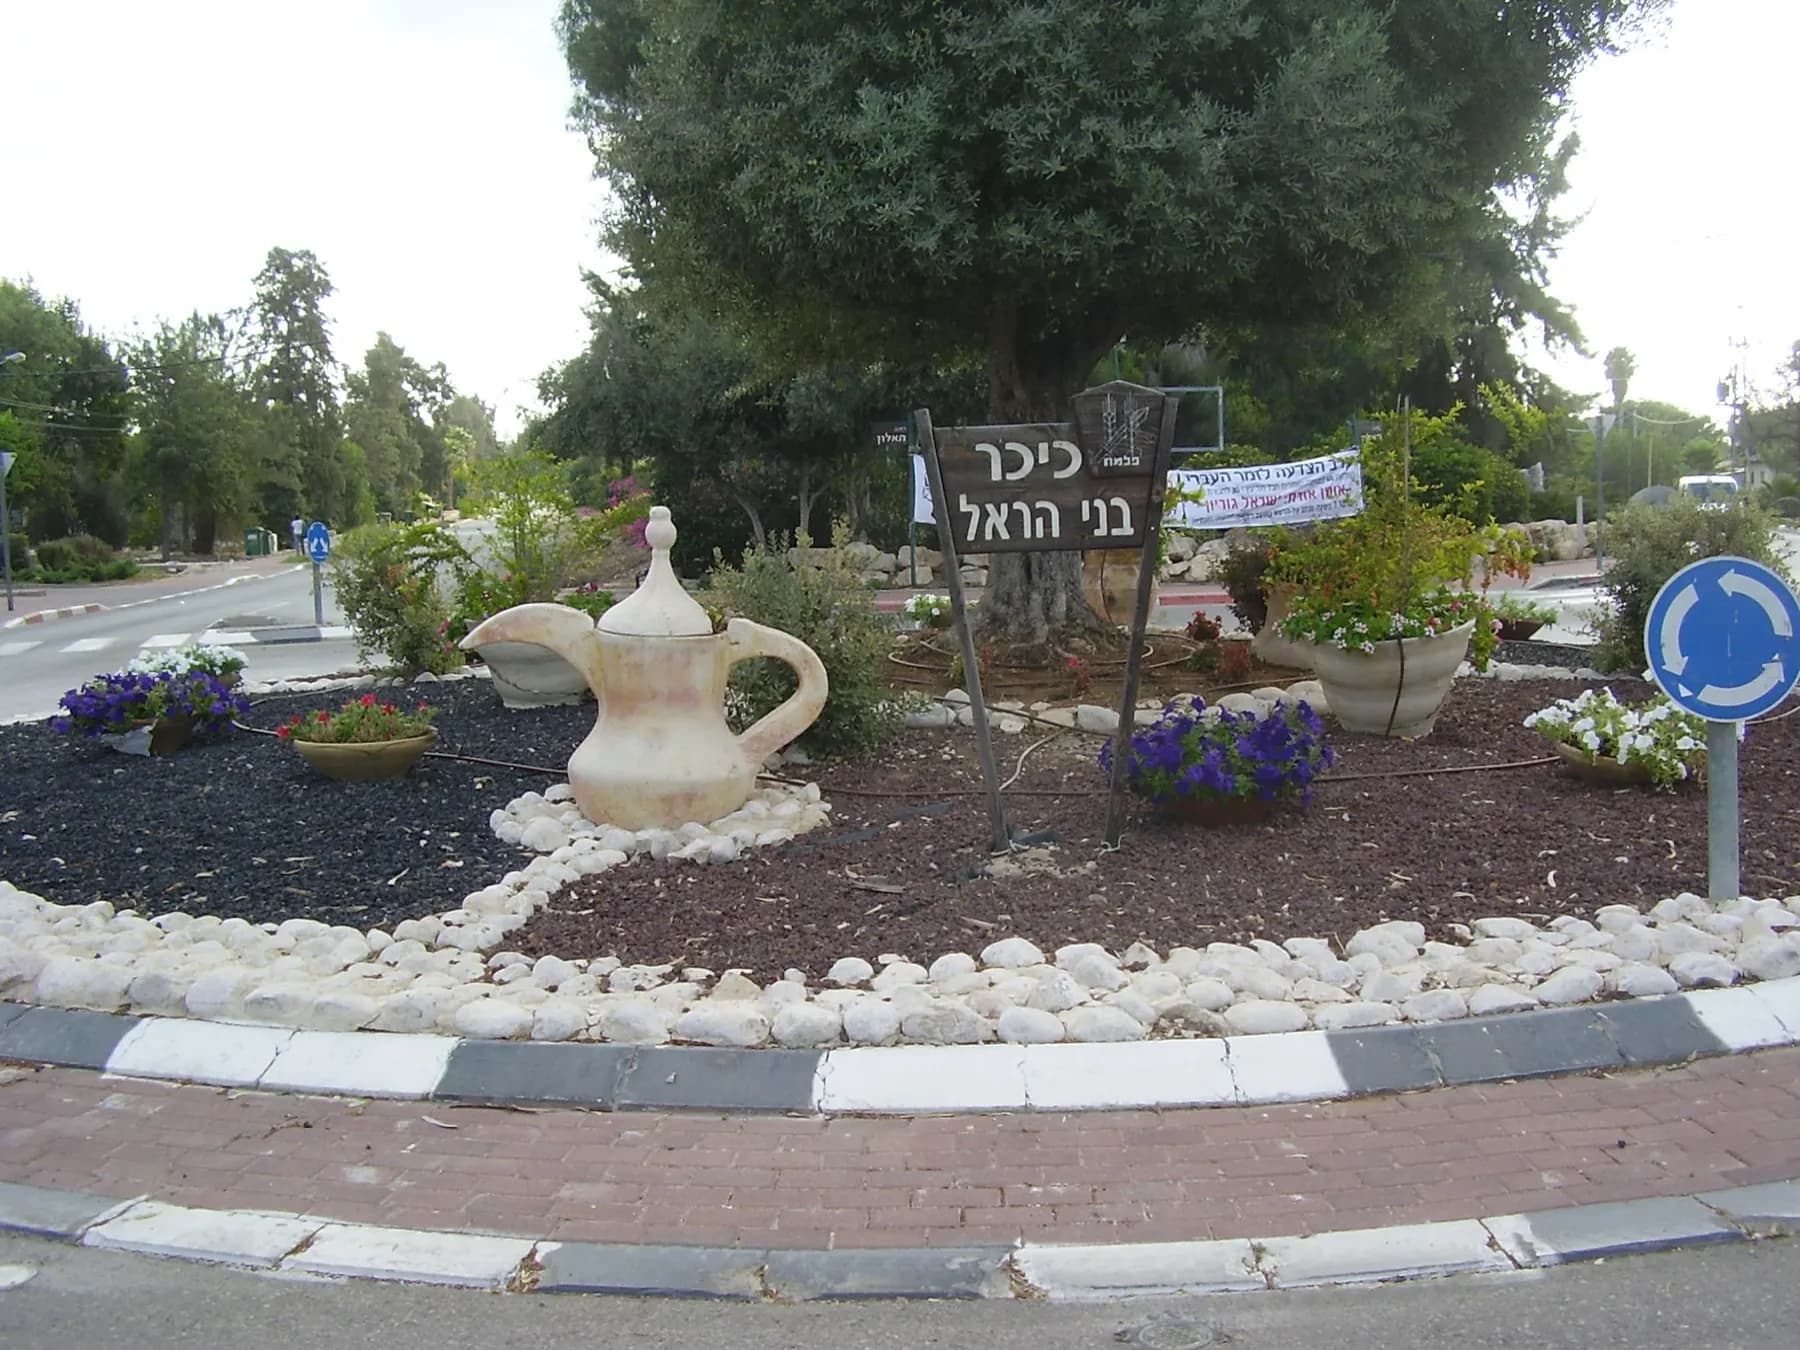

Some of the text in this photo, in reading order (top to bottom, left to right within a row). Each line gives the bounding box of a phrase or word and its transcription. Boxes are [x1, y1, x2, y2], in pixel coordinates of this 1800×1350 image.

[877, 432, 906, 445] האלון
[975, 440, 1083, 481] כיכר
[1233, 467, 1270, 482] לזמר
[1276, 461, 1326, 479] הצדעה
[1186, 471, 1232, 486] העברי
[959, 493, 1135, 542] בני הראל
